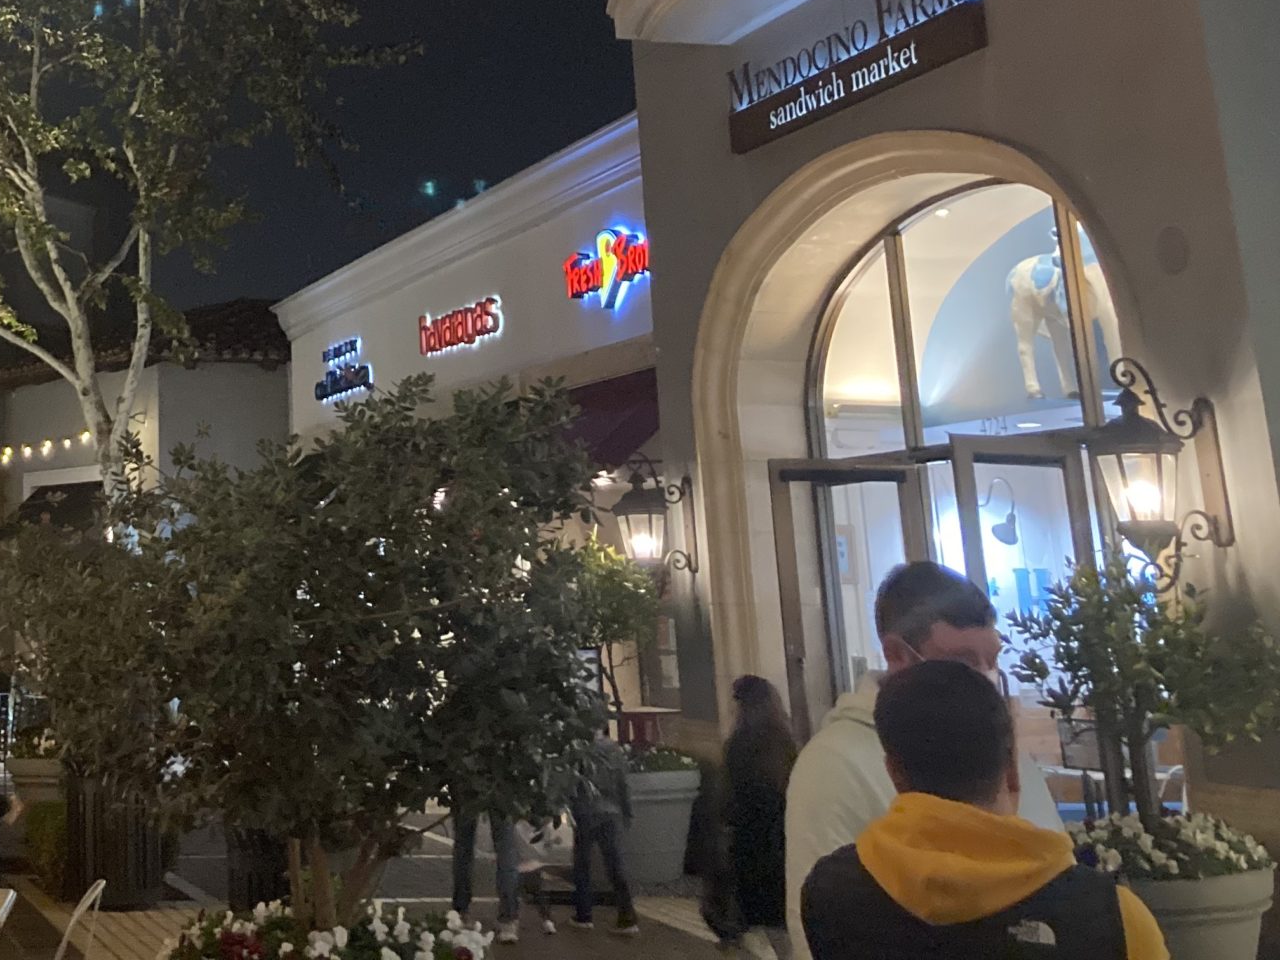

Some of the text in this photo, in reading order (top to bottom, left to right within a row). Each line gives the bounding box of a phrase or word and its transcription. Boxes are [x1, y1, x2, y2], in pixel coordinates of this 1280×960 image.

[726, 19, 868, 113] MENDOCINO
[769, 40, 919, 130] sandwich market
